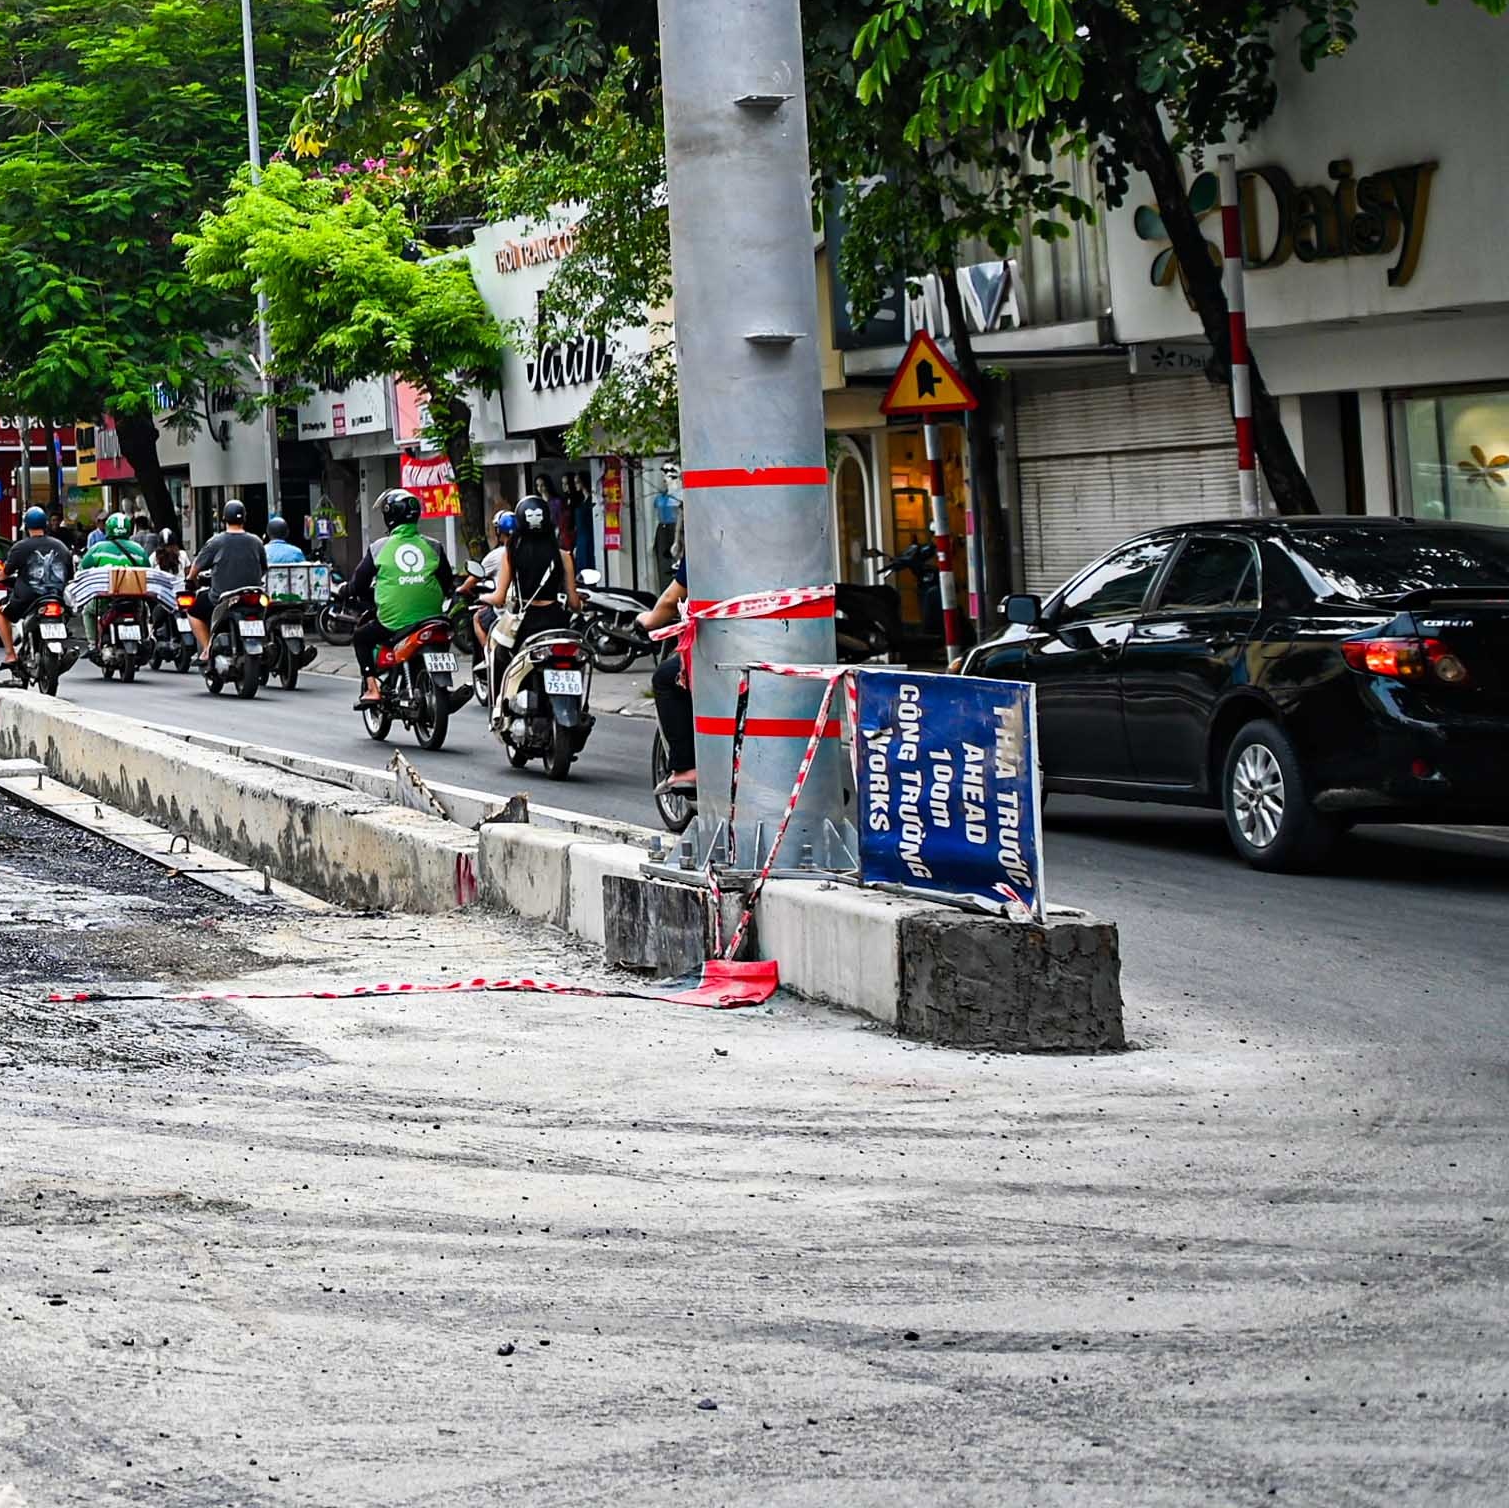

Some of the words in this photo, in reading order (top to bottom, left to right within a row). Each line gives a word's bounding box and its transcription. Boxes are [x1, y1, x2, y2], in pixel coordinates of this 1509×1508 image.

[1235, 159, 1439, 287] Daisy
[398, 576, 425, 586] gojek
[897, 684, 923, 762] CÔNG
[898, 770, 933, 879] TRƯỜNG
[929, 747, 954, 828] 100m
[962, 742, 988, 844] AHEAD
[997, 791, 1032, 888] TRƯỚC
